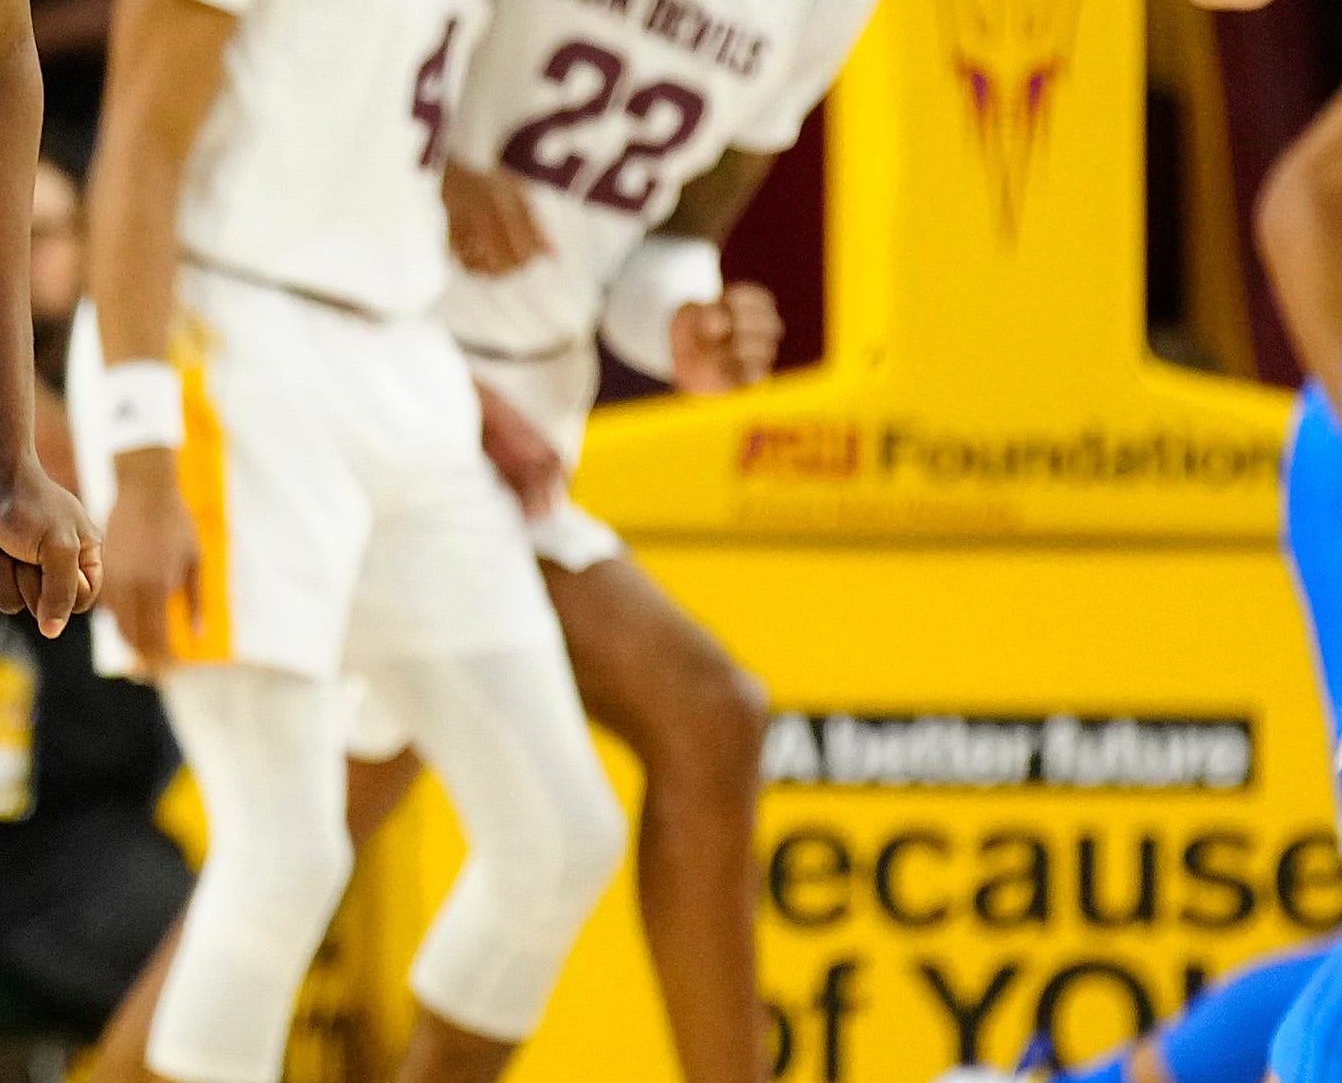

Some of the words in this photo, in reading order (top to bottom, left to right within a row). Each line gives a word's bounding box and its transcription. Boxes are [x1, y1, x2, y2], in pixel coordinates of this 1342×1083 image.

[500, 36, 706, 214] 22
[877, 422, 1283, 482] Foundation
[760, 713, 820, 783] A
[824, 711, 1031, 785] better
[1041, 712, 1251, 785] future
[910, 958, 1206, 1078] YO
